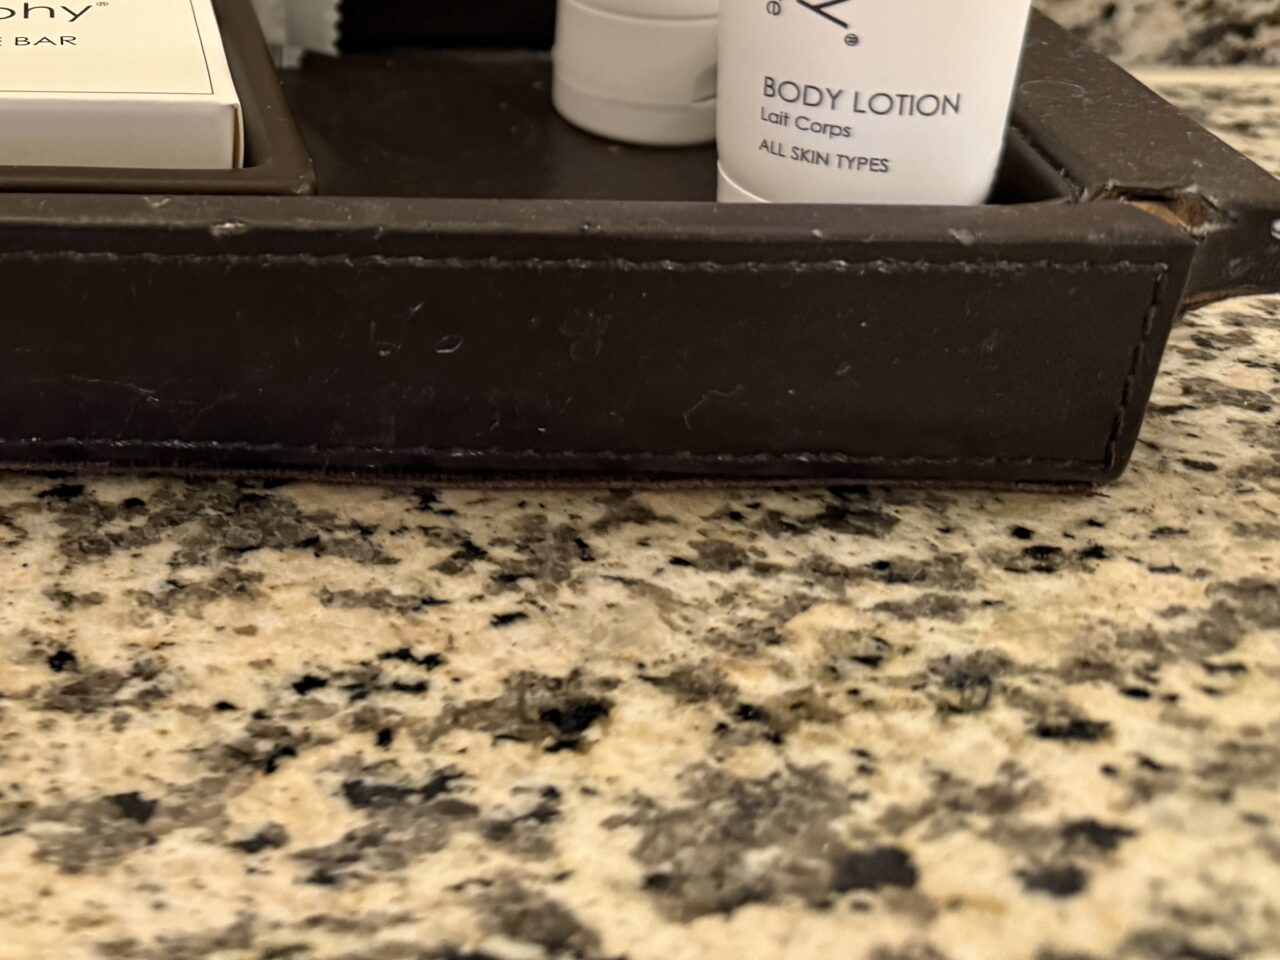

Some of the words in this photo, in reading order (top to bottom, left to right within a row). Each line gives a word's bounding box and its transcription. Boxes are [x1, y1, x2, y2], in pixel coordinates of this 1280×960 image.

[14, 35, 77, 46] BAR
[763, 75, 844, 111] BODY
[852, 90, 961, 117] LOTION
[760, 105, 790, 127] Lait
[794, 114, 852, 139] Corps
[758, 138, 786, 158] ALL
[790, 145, 829, 167] SKIN
[835, 153, 890, 174] TYPES
